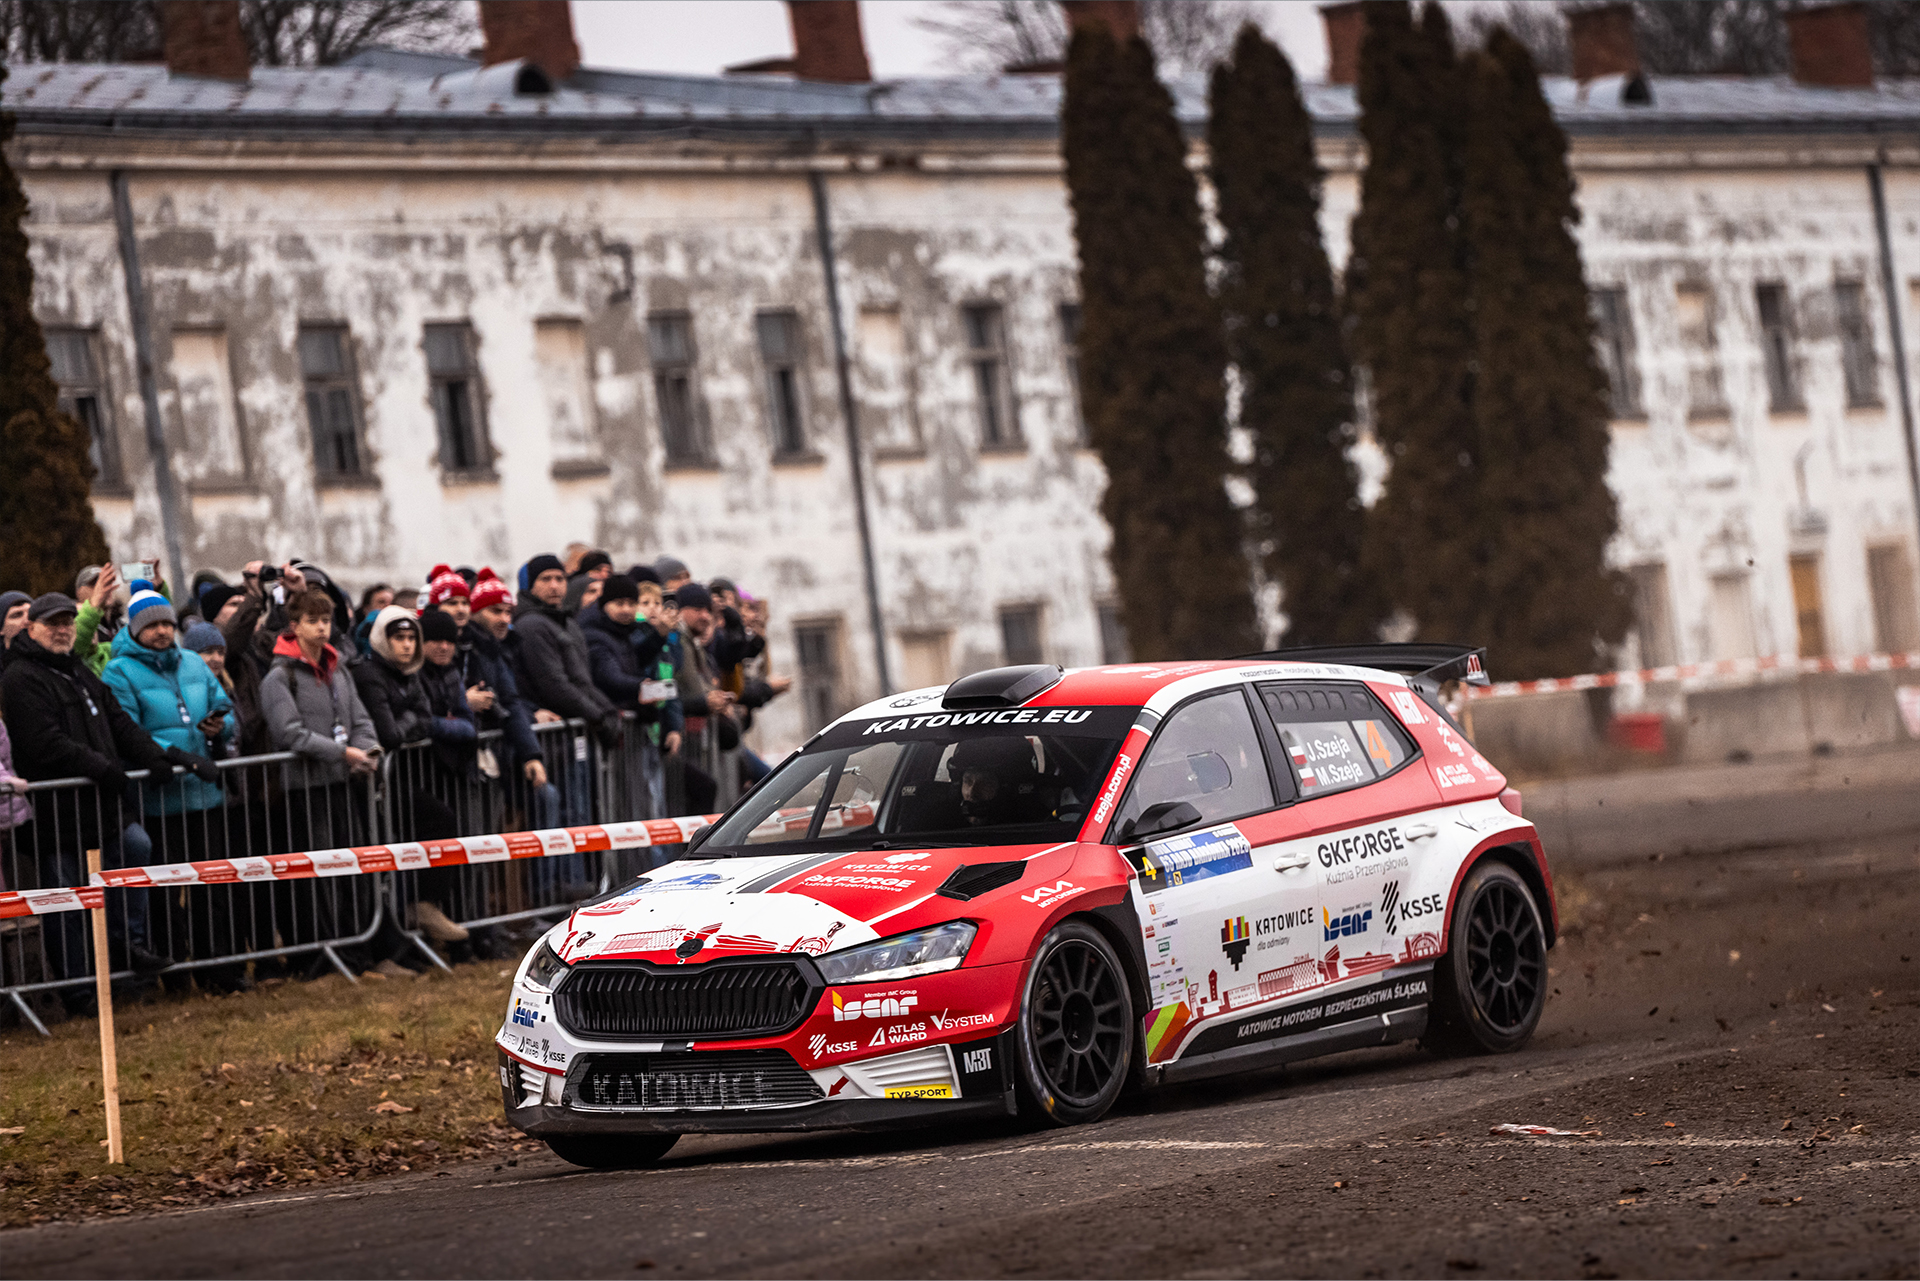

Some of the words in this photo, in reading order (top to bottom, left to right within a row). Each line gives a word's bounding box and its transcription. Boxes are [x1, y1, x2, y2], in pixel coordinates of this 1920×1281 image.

[862, 709, 1093, 735] KATOWICE.EU
[1307, 735, 1350, 762] J.Szeja
[1366, 721, 1392, 768] 4
[1315, 760, 1363, 786] M.Szeja
[1094, 754, 1131, 824] szeja.com.pl
[1317, 827, 1404, 868] GKFORGE
[1142, 856, 1157, 881] 4
[1325, 867, 1354, 885] Kuźnia
[1355, 856, 1409, 875] Przemysłowa
[1400, 894, 1443, 921] KSSE
[1256, 907, 1314, 936] KATOWICE
[864, 990, 886, 998] Member
[1237, 1016, 1282, 1038] KATOWICE
[1282, 1006, 1323, 1027] MOTOREM
[1325, 988, 1393, 1017] BEZPIECZEŃSTWA
[1394, 980, 1427, 1000] ŚLĄSKA
[888, 1022, 926, 1034] ATLAS
[888, 1031, 927, 1044] WARD
[548, 1051, 566, 1063] KSSE
[826, 1041, 857, 1054] KSSE
[593, 1070, 775, 1106] KATOWICE
[913, 1088, 947, 1098] SPORT
